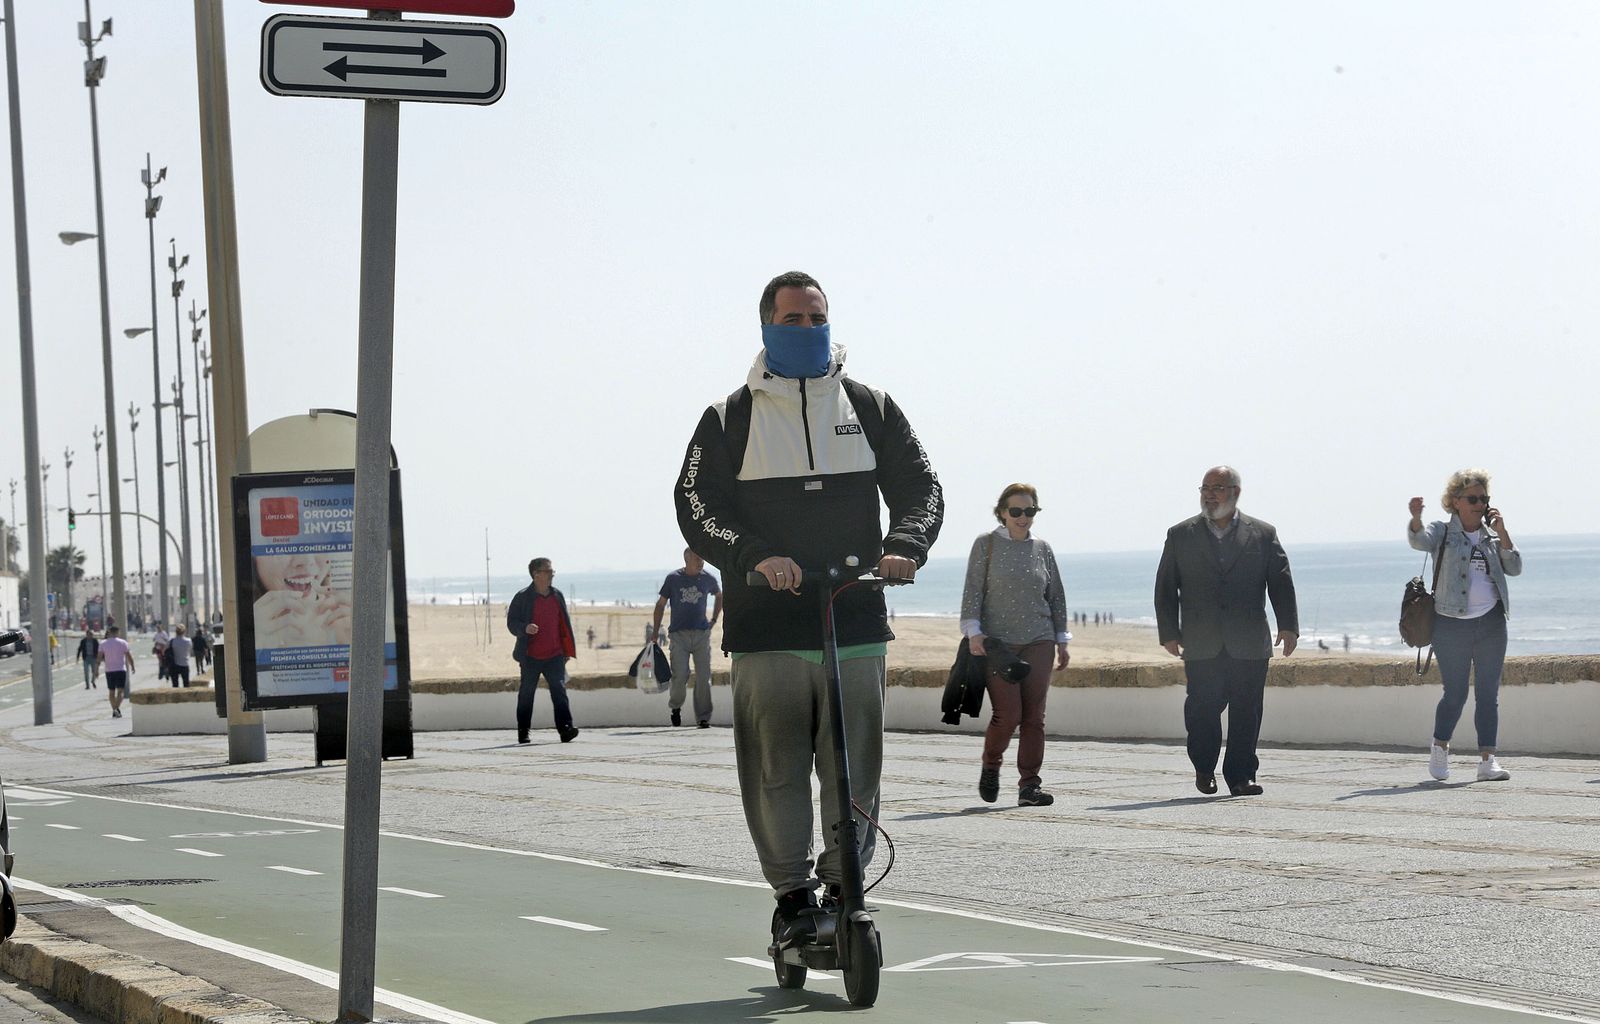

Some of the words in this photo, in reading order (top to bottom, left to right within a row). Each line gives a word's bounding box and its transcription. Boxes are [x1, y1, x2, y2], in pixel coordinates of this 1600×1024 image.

[683, 444, 703, 488] Center
[303, 499, 339, 507] UNIDAD
[684, 490, 706, 520] Spac
[303, 509, 354, 519] ORTODON
[303, 520, 353, 534] INVISI
[299, 544, 336, 552] COMIENZA
